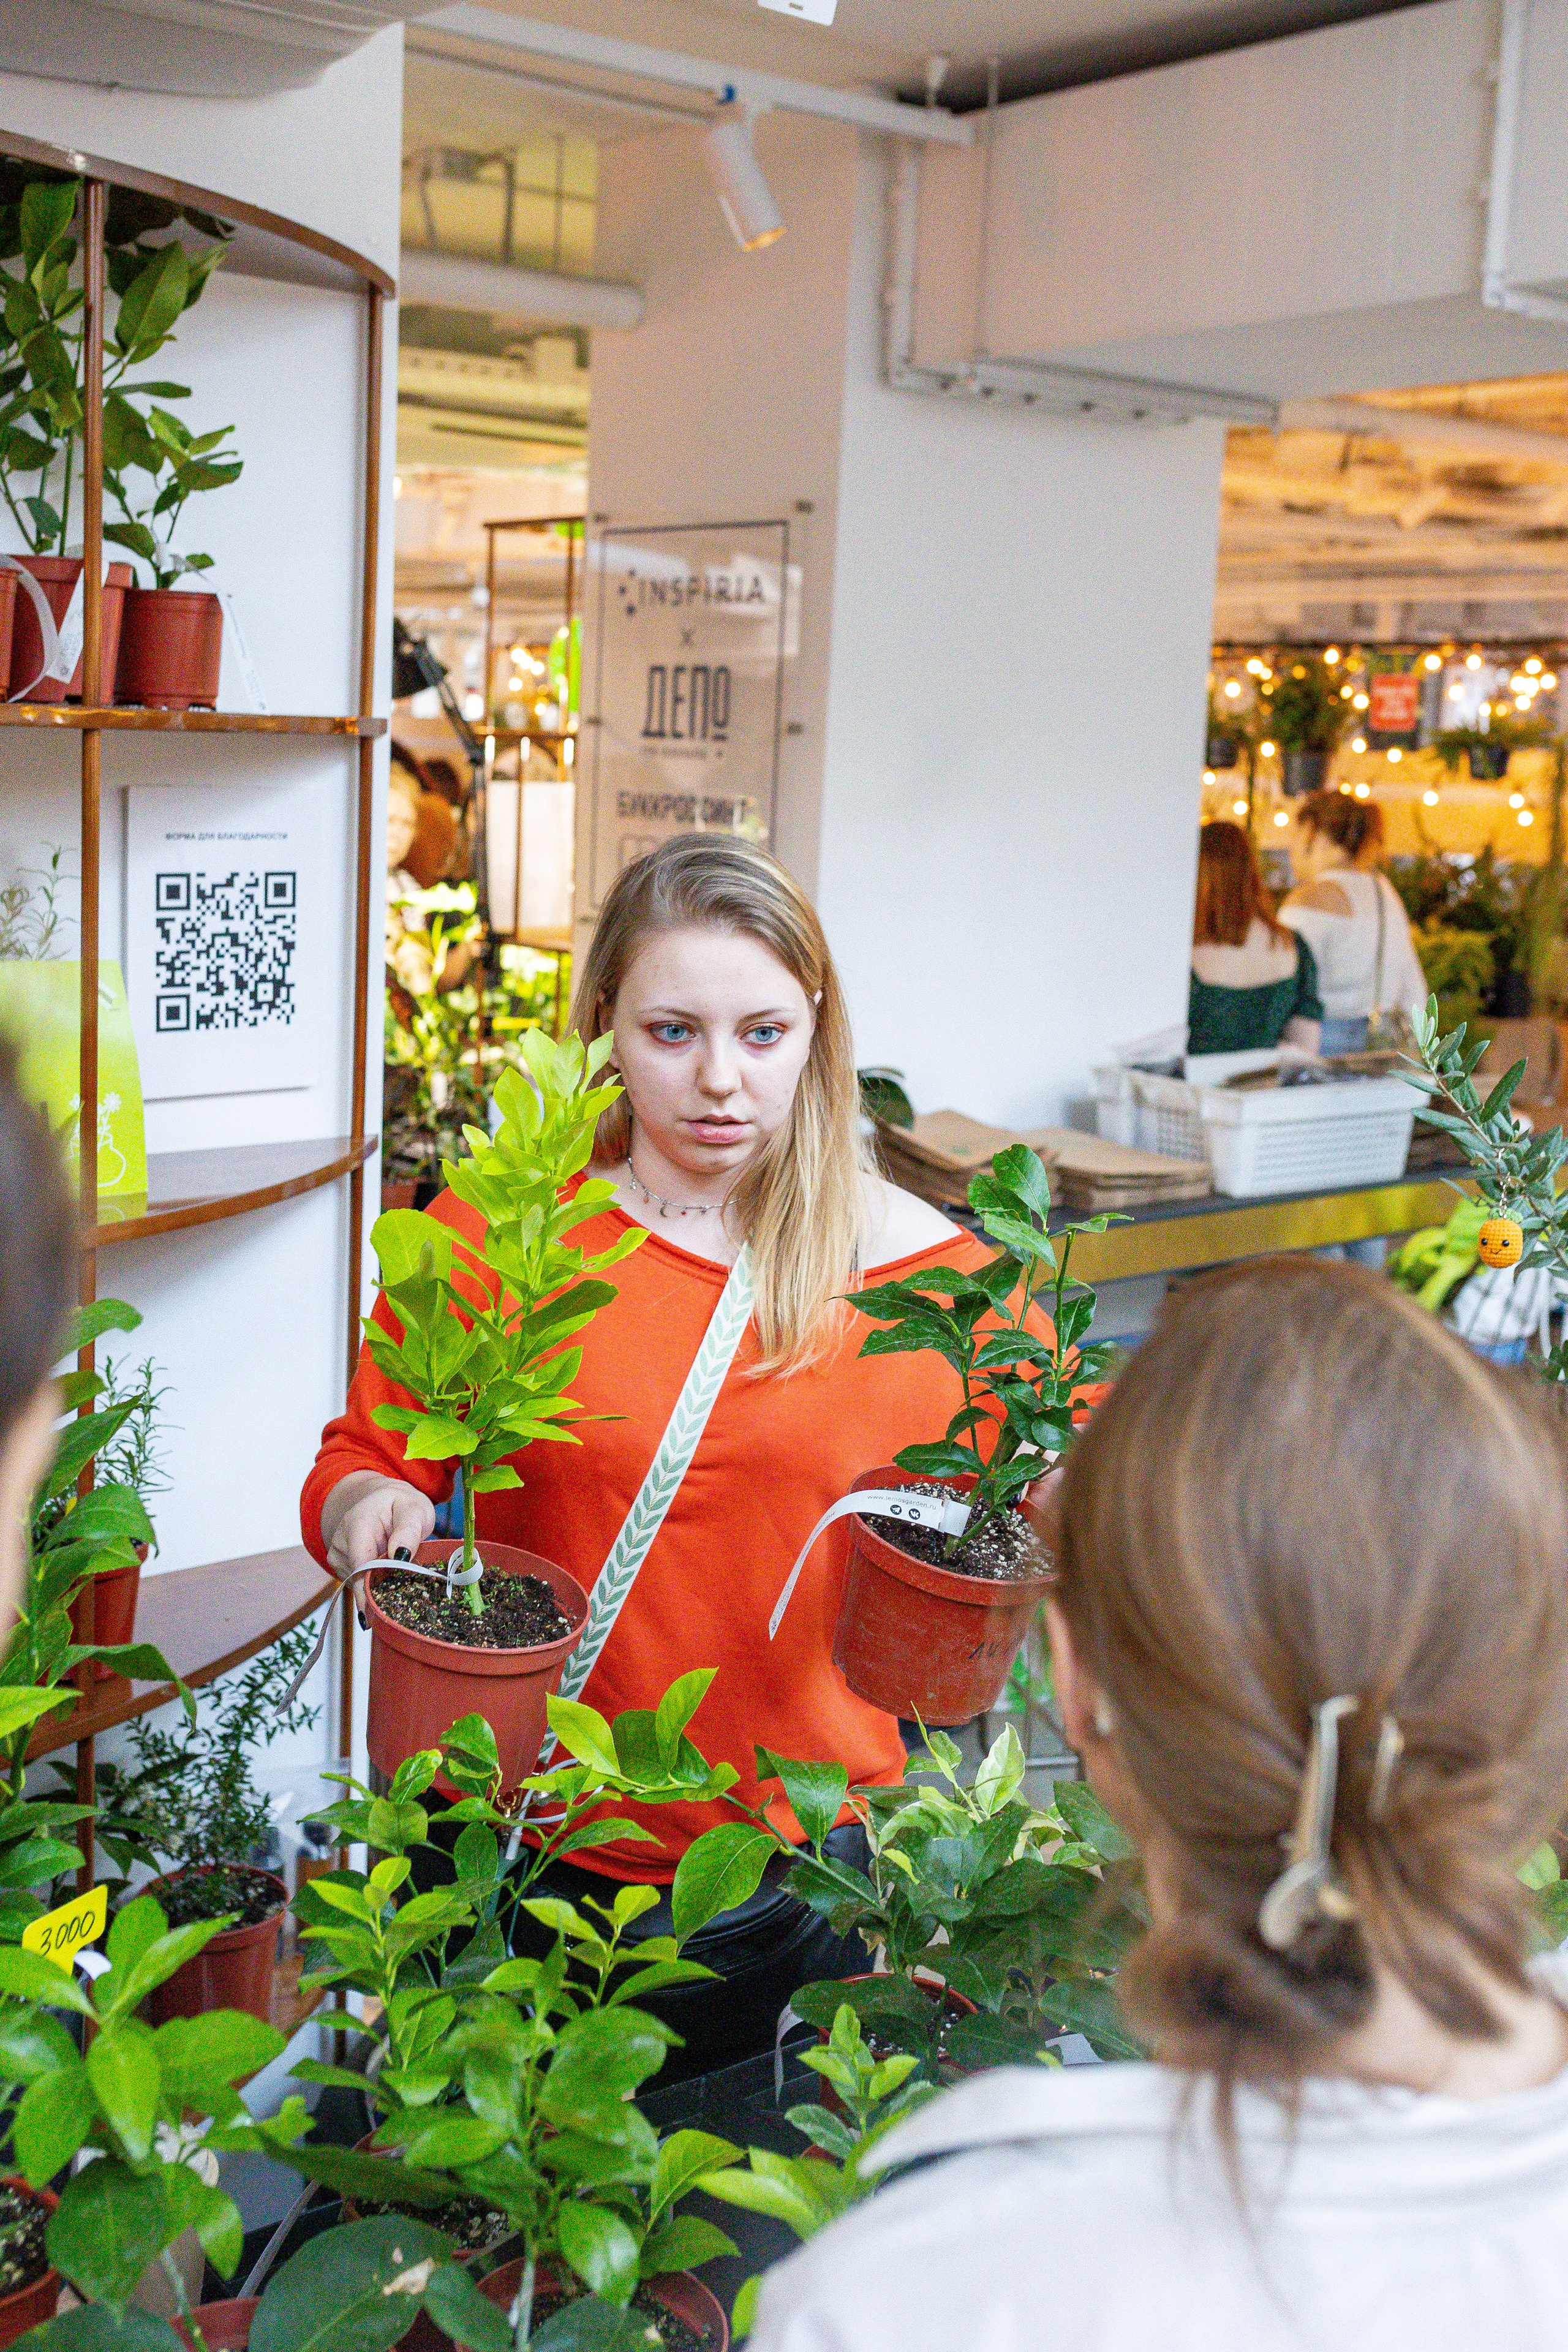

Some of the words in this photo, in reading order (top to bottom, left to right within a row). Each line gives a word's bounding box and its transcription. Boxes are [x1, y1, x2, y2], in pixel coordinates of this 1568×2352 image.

[638, 576, 766, 606] INSPIRIA
[641, 663, 732, 741] ДЕПО
[867, 1495, 937, 1510] www.lemosgarden.ru
[40, 1910, 96, 1956] 3000
